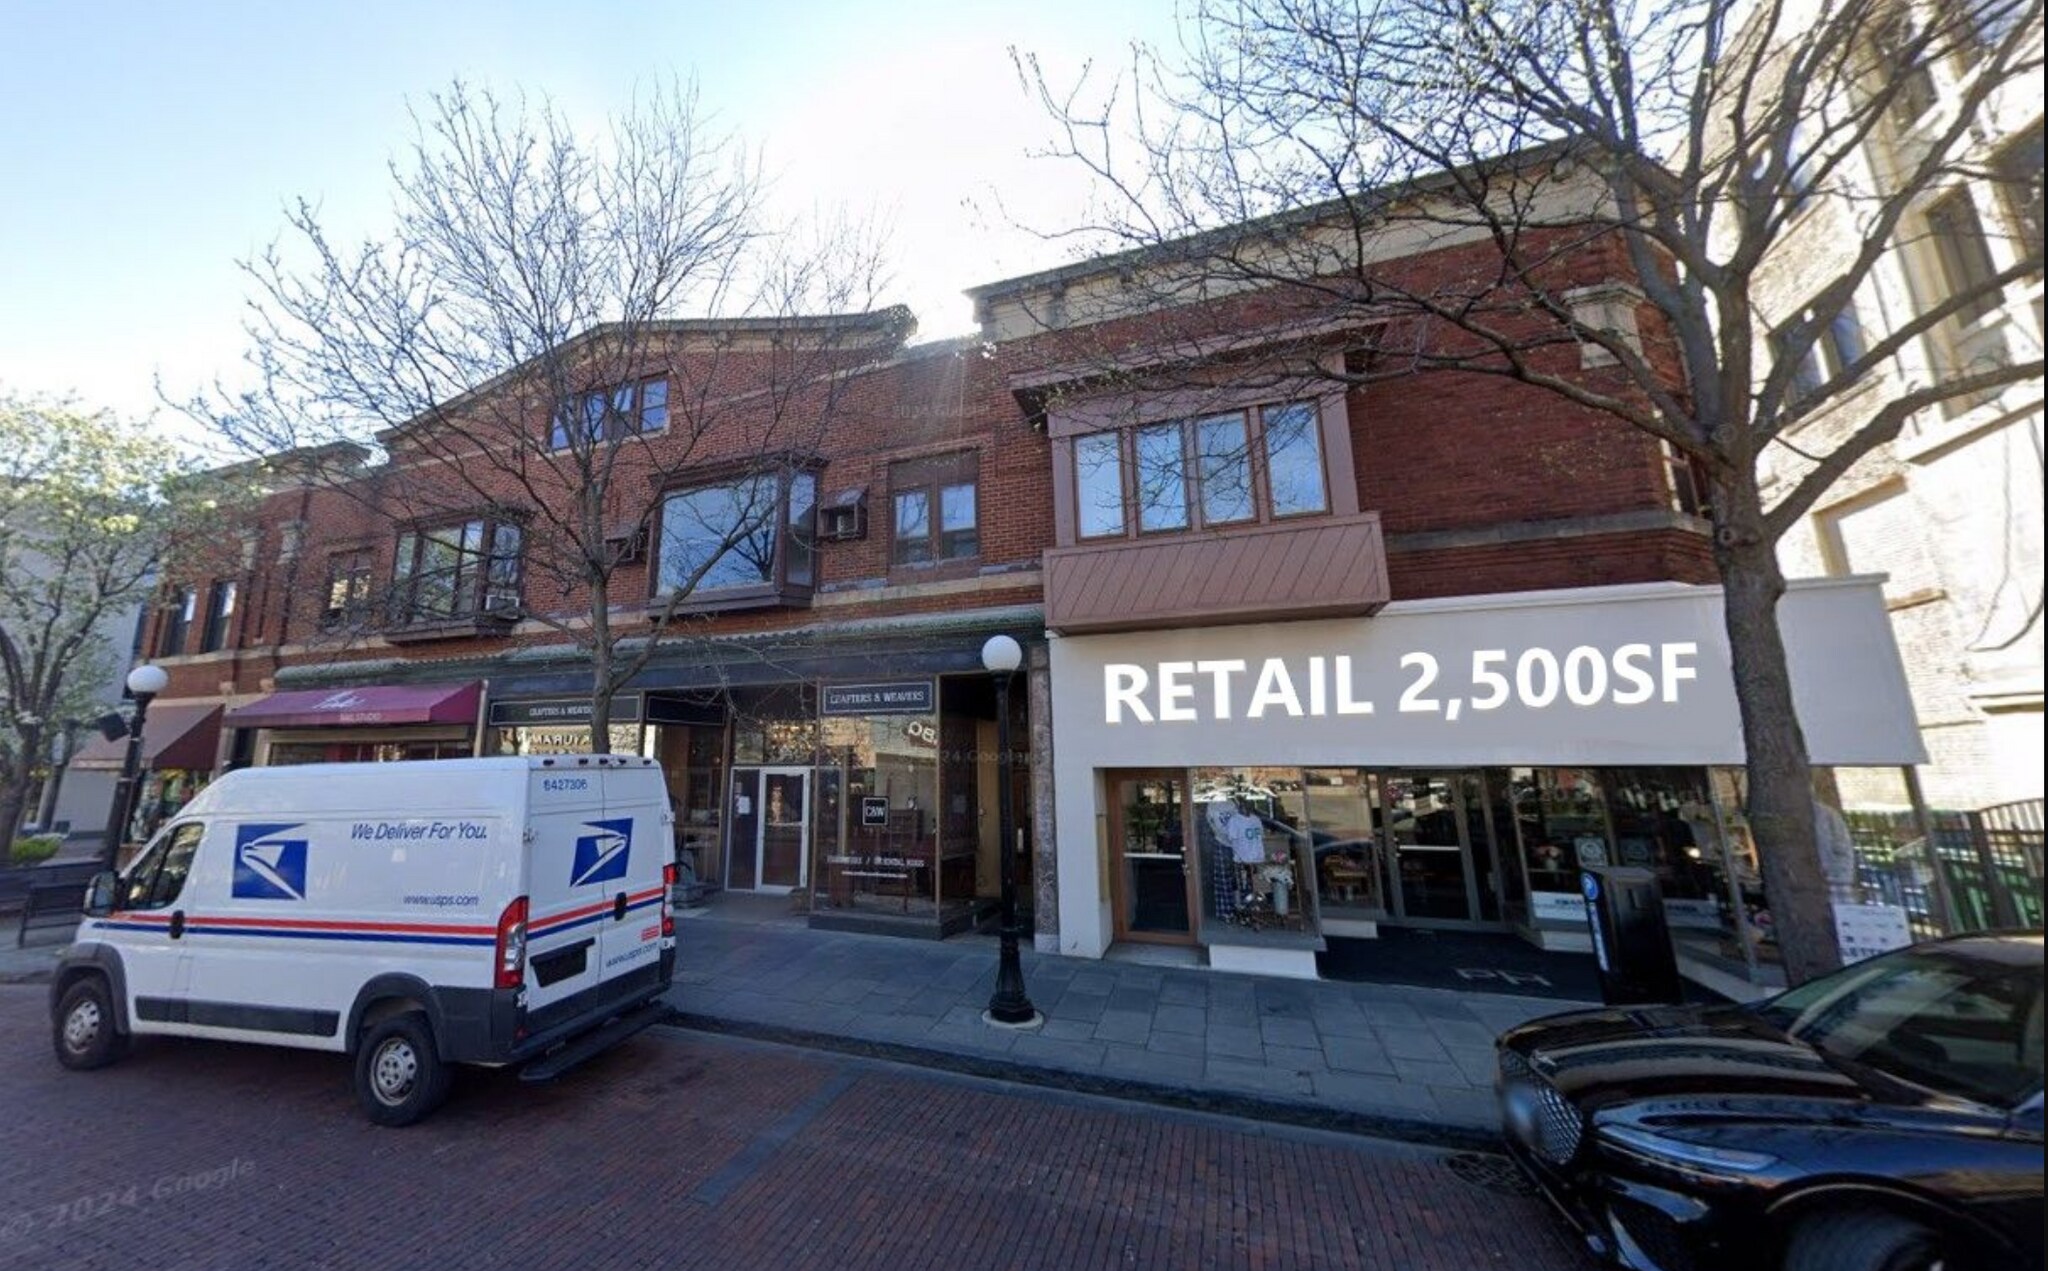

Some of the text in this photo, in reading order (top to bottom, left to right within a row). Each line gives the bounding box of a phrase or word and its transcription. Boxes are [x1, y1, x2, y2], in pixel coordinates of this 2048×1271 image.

[567, 705, 594, 715] WEAVER
[351, 821, 488, 840] We Deliver For You.
[402, 894, 480, 908] www.usps.com
